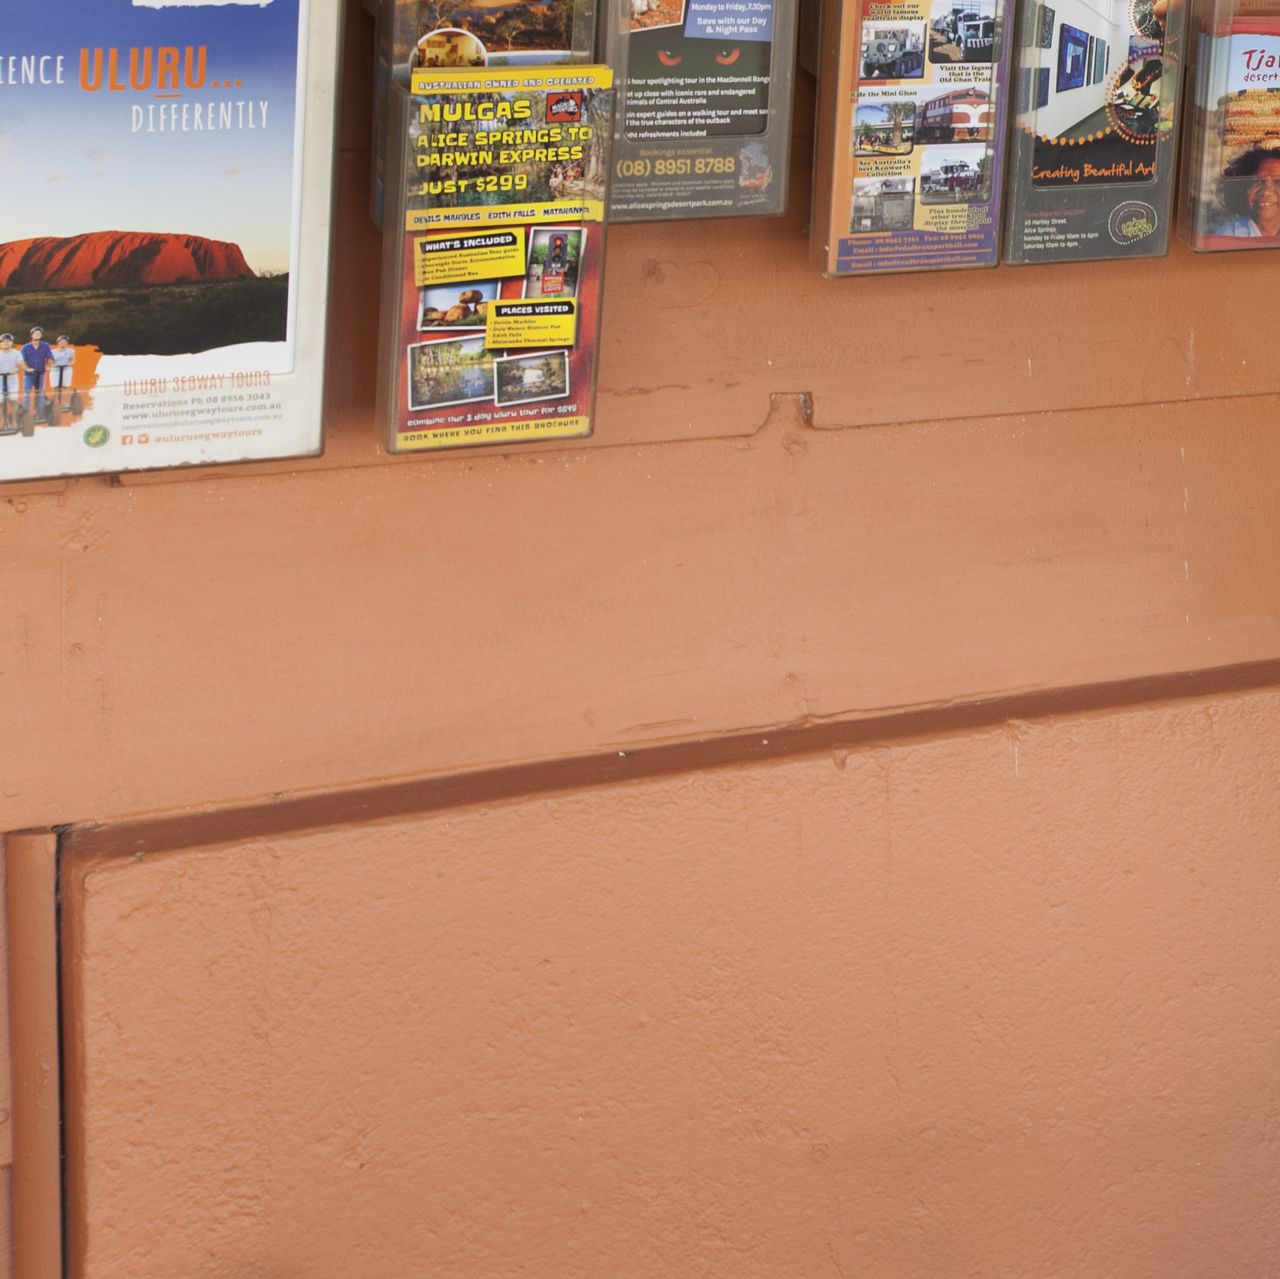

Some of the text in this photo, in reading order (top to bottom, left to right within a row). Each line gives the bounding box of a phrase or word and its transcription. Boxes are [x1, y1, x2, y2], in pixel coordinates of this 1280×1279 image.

[1243, 71, 1279, 82] desert
[132, 101, 270, 133] DIFFERENTLY
[419, 100, 532, 124] MULGAS
[417, 128, 562, 148] ALICE SPRINGS
[416, 146, 583, 168] DARWIN EXPRESS
[616, 156, 735, 178] (08) 8951 8788
[1031, 161, 1133, 182] Creating Beautiful
[417, 174, 528, 196] JUST $299
